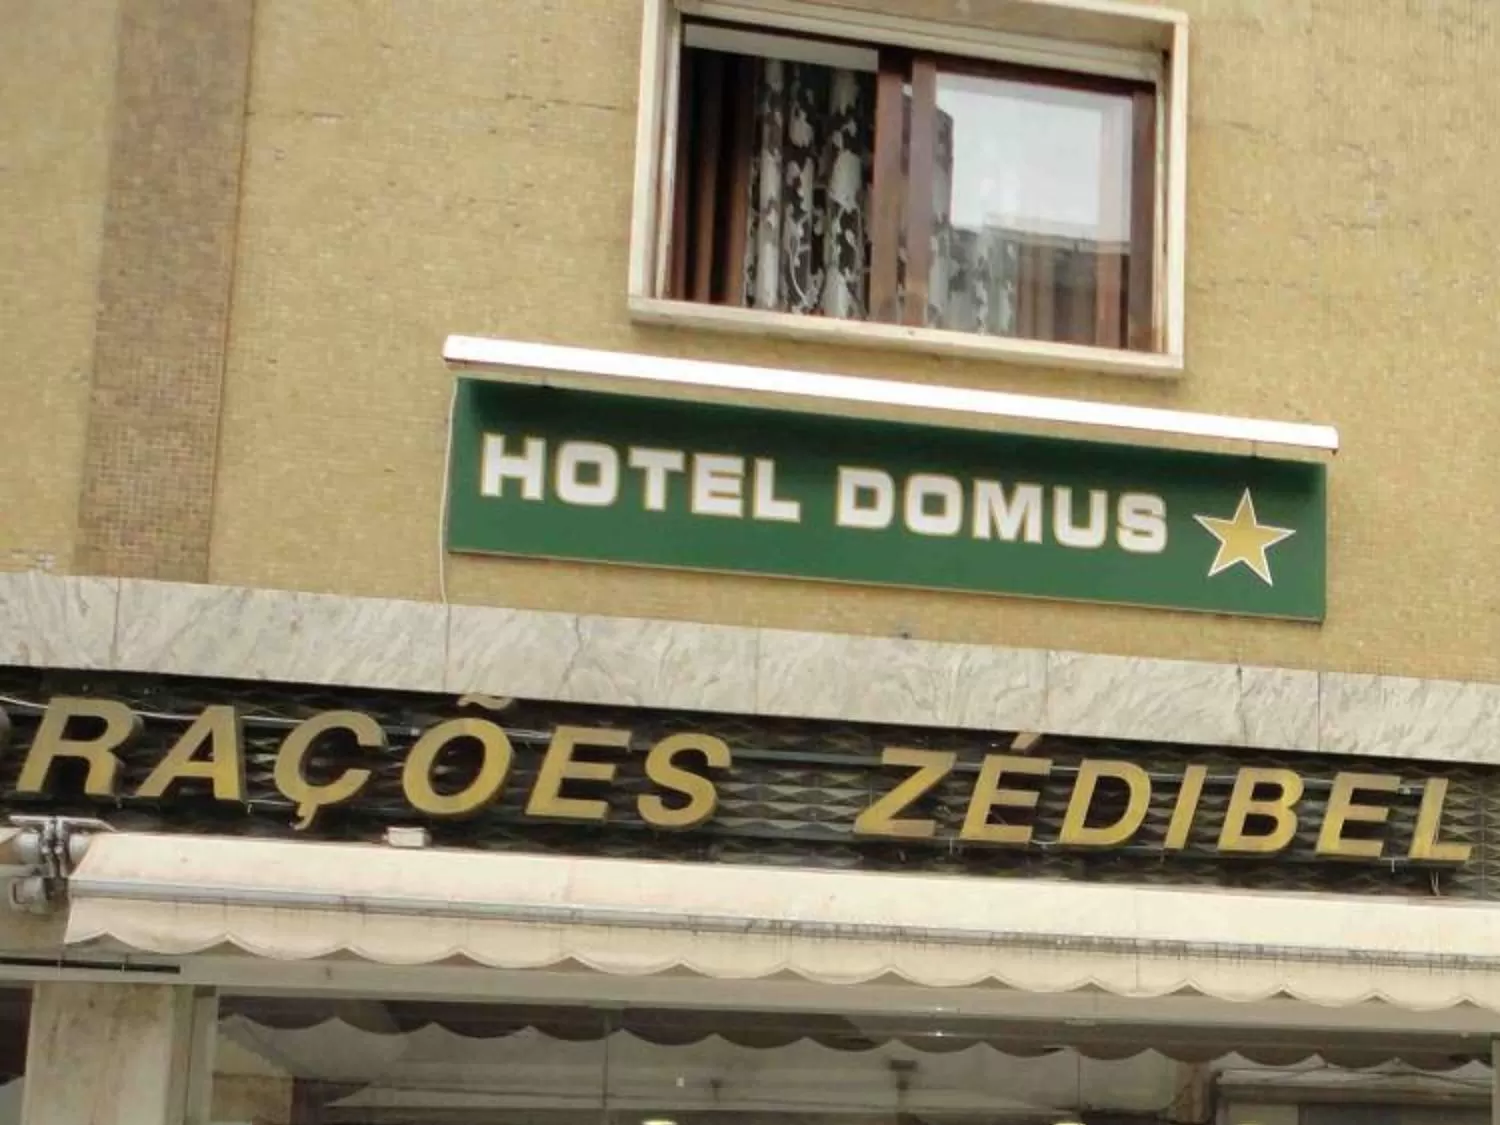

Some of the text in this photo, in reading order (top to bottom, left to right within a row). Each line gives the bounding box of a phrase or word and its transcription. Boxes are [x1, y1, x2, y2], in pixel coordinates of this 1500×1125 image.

[479, 433, 1170, 554] HOTEL DOMUS
[0, 692, 1472, 867] RAÇÕES ZÉDIBEL
